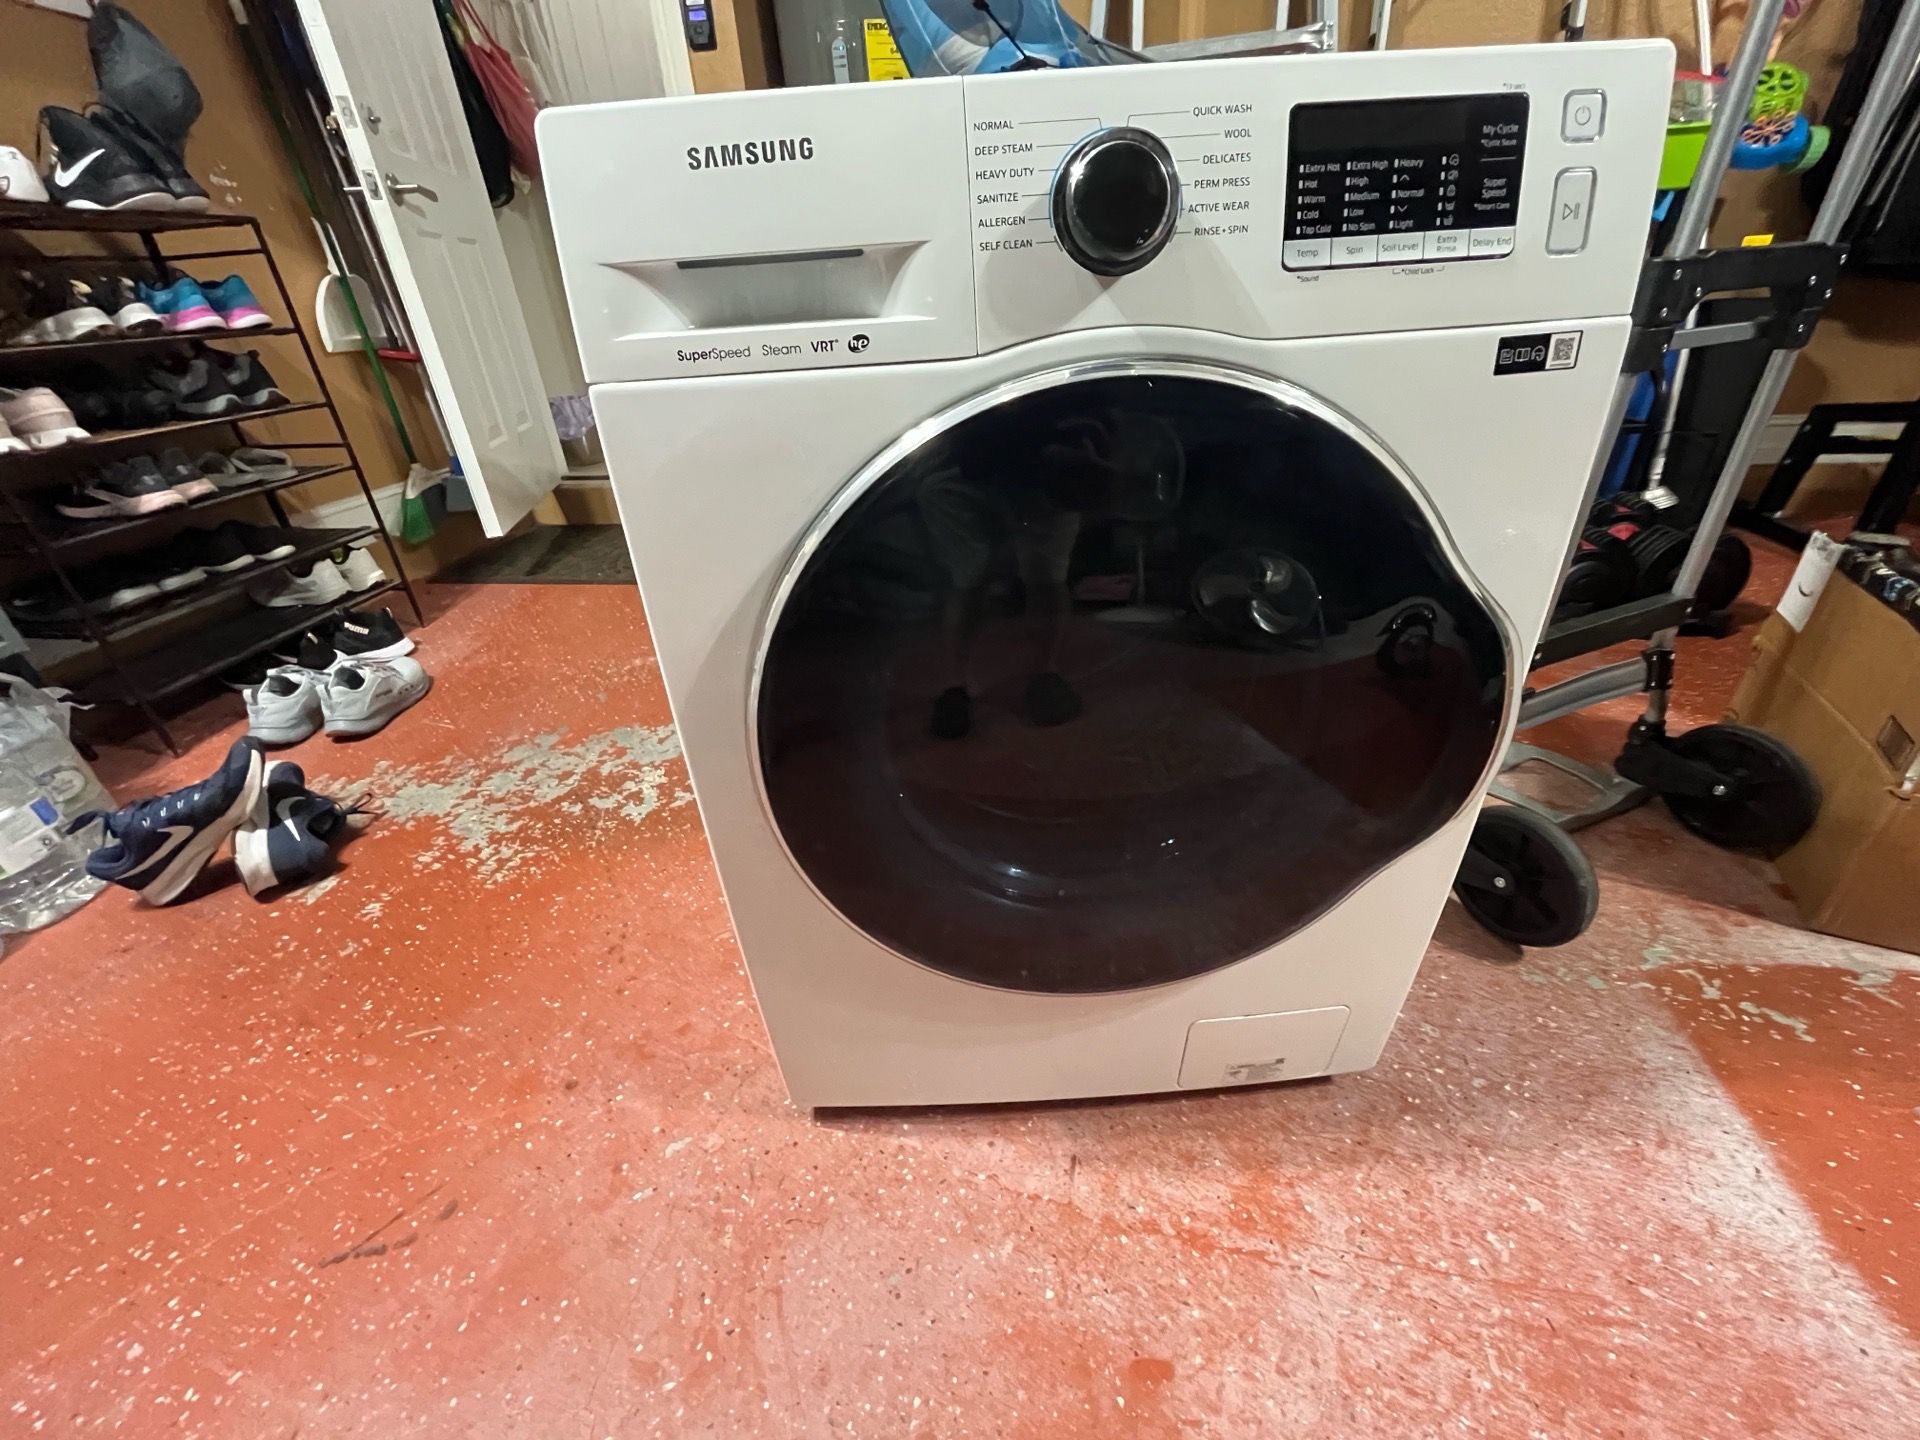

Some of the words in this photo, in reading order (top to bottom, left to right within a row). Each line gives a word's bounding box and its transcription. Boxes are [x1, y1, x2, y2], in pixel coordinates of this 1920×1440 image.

[1193, 105, 1222, 118] QUICK
[1224, 104, 1253, 114] WASH
[973, 120, 1015, 131] NORMAL
[1224, 128, 1252, 139] WOOL
[687, 137, 814, 170] SAMSUNG
[974, 145, 999, 156] DEEP
[1001, 143, 1033, 154] STEAM
[1203, 152, 1252, 165] DELICATES
[1400, 159, 1424, 168] Heavy
[1305, 164, 1326, 173] Extra
[1327, 163, 1340, 171] Hot
[1352, 161, 1371, 171] Extra
[1371, 160, 1389, 170] High
[975, 169, 1007, 180] HEAVY
[1009, 167, 1035, 178] DUTY
[1194, 178, 1220, 189] PERM
[1222, 176, 1251, 187] PRESS
[1304, 180, 1318, 189] Hot
[1350, 176, 1369, 187] High
[977, 192, 1019, 204] SANITIZE
[1350, 191, 1380, 201] Medium
[1397, 188, 1425, 198] Normal
[1303, 195, 1326, 204] Warm
[1188, 202, 1220, 213] ACTIVE
[1222, 200, 1250, 211] WEAR
[1302, 210, 1320, 219] Cold
[1349, 208, 1364, 217] Low
[978, 216, 1026, 228] ALLERGEN
[1348, 223, 1359, 231] No
[1359, 222, 1376, 232] Spin
[1394, 219, 1414, 230] Light
[1194, 226, 1221, 236] RINSE
[1227, 224, 1249, 235] SPIN
[1302, 226, 1315, 235] Tap
[1315, 224, 1332, 234] Cold
[1437, 235, 1458, 244] Extra
[1472, 239, 1495, 249] Delay
[1497, 237, 1512, 246] End
[979, 241, 1001, 252] SELF
[1003, 239, 1033, 250] CLEAN
[1346, 246, 1364, 255] Spin
[1381, 243, 1396, 253] Soil
[1397, 243, 1419, 252] Level
[1436, 245, 1457, 253] Rinse
[1297, 249, 1319, 258] Temp
[677, 345, 751, 363] SuperSpeed
[762, 344, 802, 357] Steam
